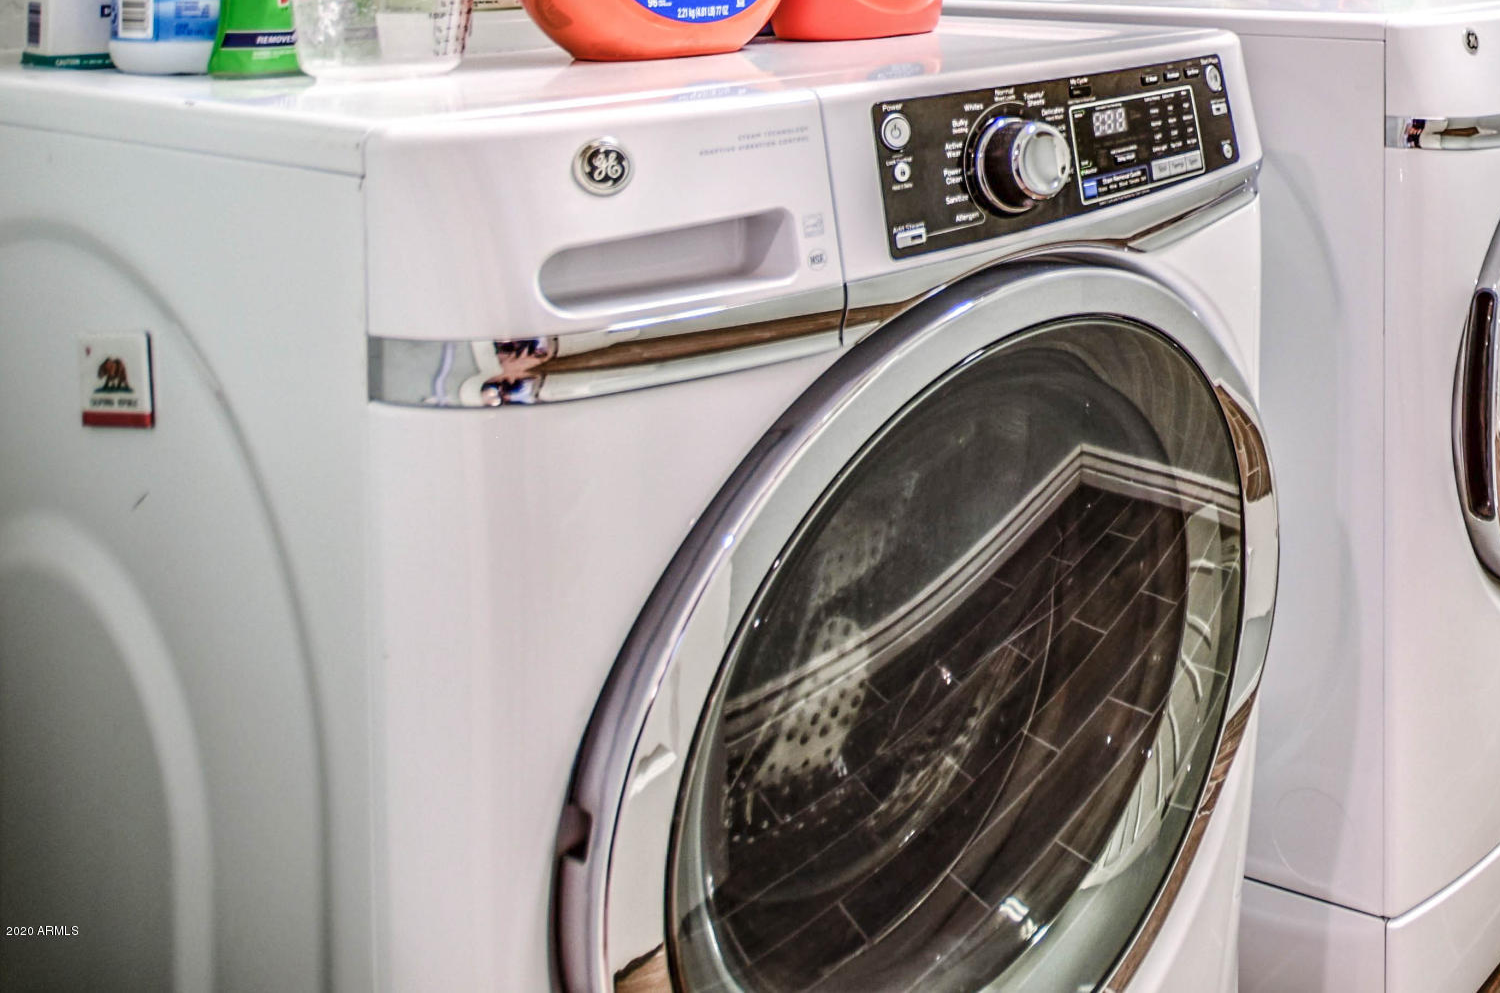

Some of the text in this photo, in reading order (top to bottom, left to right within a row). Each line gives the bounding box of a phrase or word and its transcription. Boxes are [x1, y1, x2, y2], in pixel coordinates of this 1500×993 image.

[882, 103, 903, 112] Power
[964, 103, 984, 112] Whites
[952, 119, 968, 128] Bulky
[944, 141, 963, 150] Active
[943, 168, 962, 177] Power
[946, 176, 963, 185] Clean
[946, 194, 969, 205] Sanitize
[955, 212, 980, 222] Allergen
